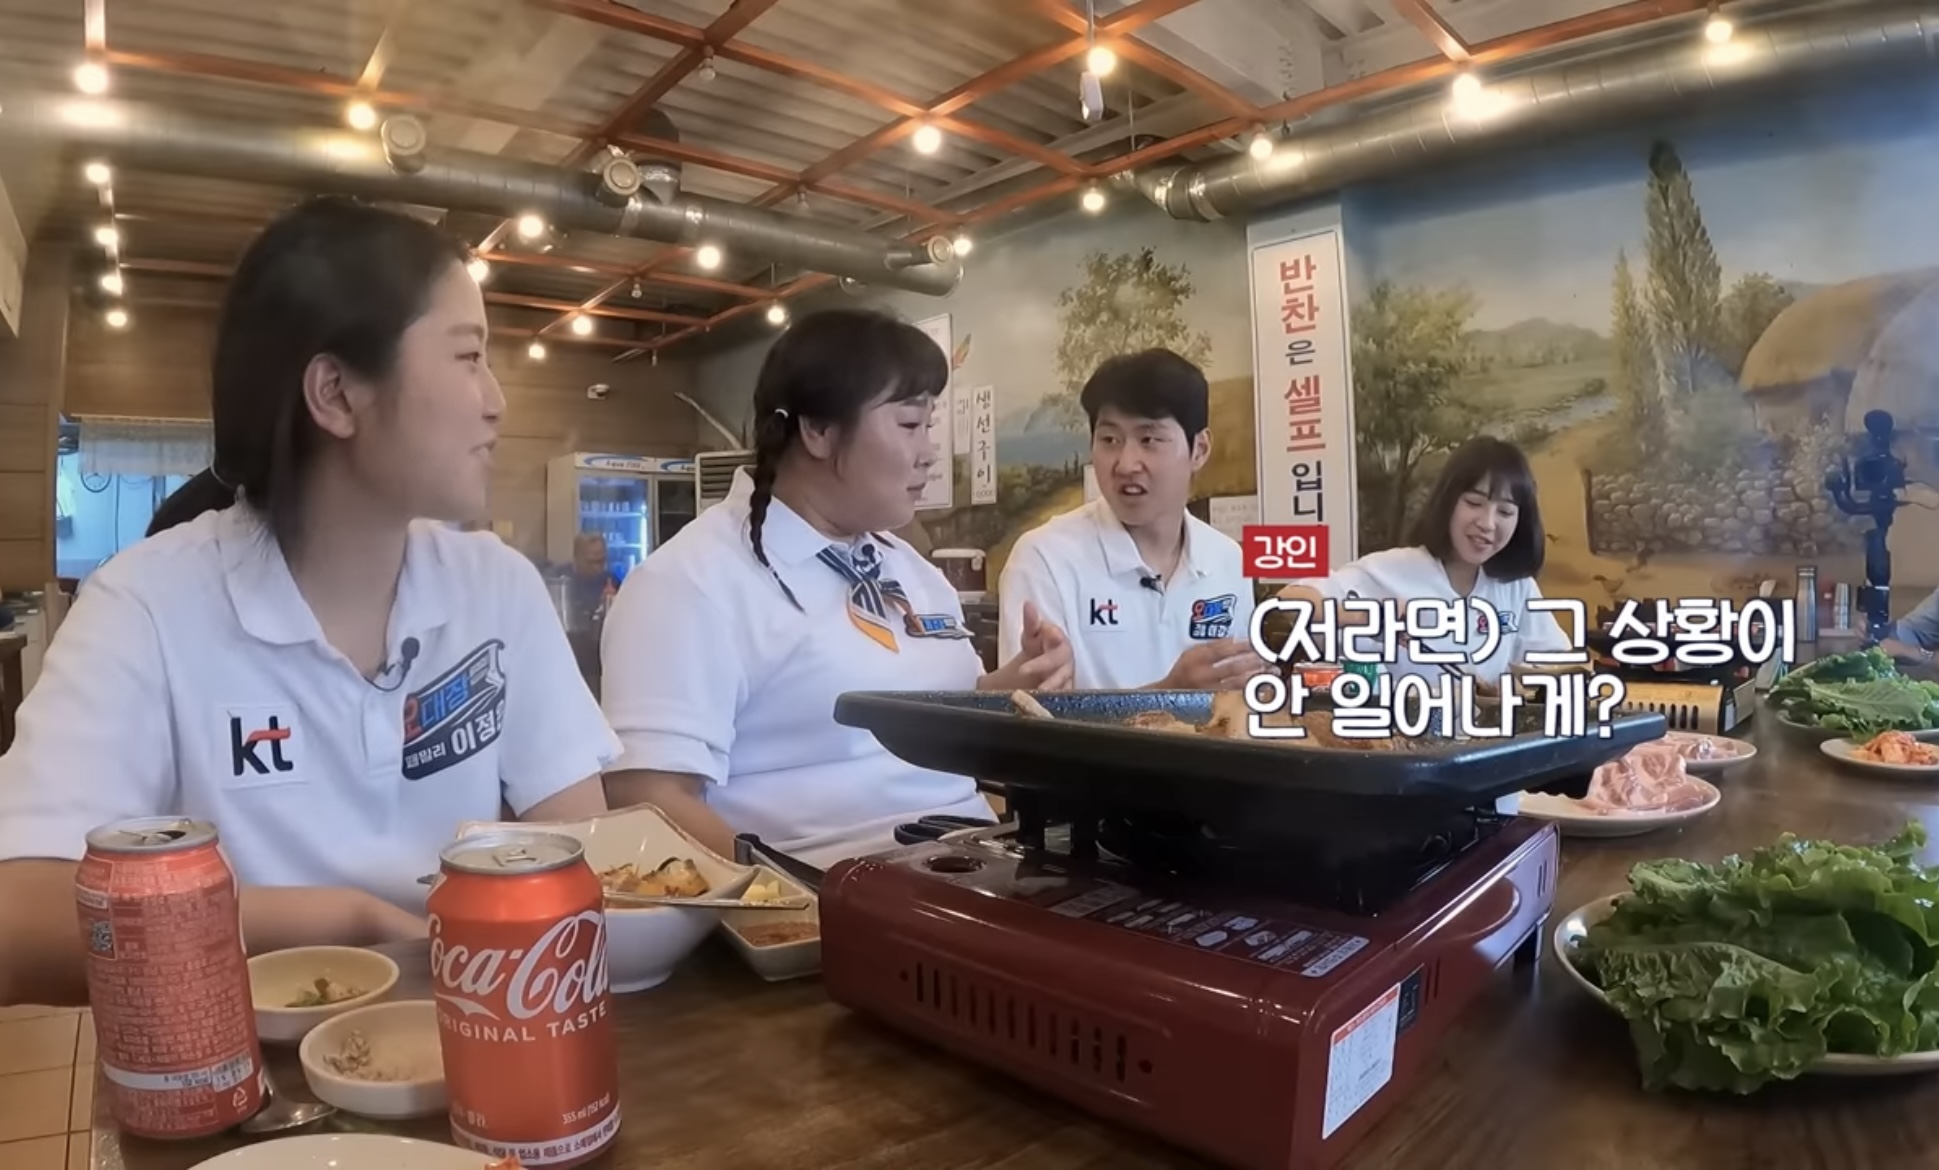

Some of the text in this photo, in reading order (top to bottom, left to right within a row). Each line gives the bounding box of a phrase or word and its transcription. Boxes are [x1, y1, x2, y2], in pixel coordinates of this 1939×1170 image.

[1279, 254, 1320, 367] 반찬은
[976, 389, 992, 484] 생선구이
[1090, 598, 1119, 626] kt
[230, 715, 293, 776] kt
[438, 1000, 606, 1042] RIGINAL TASTE
